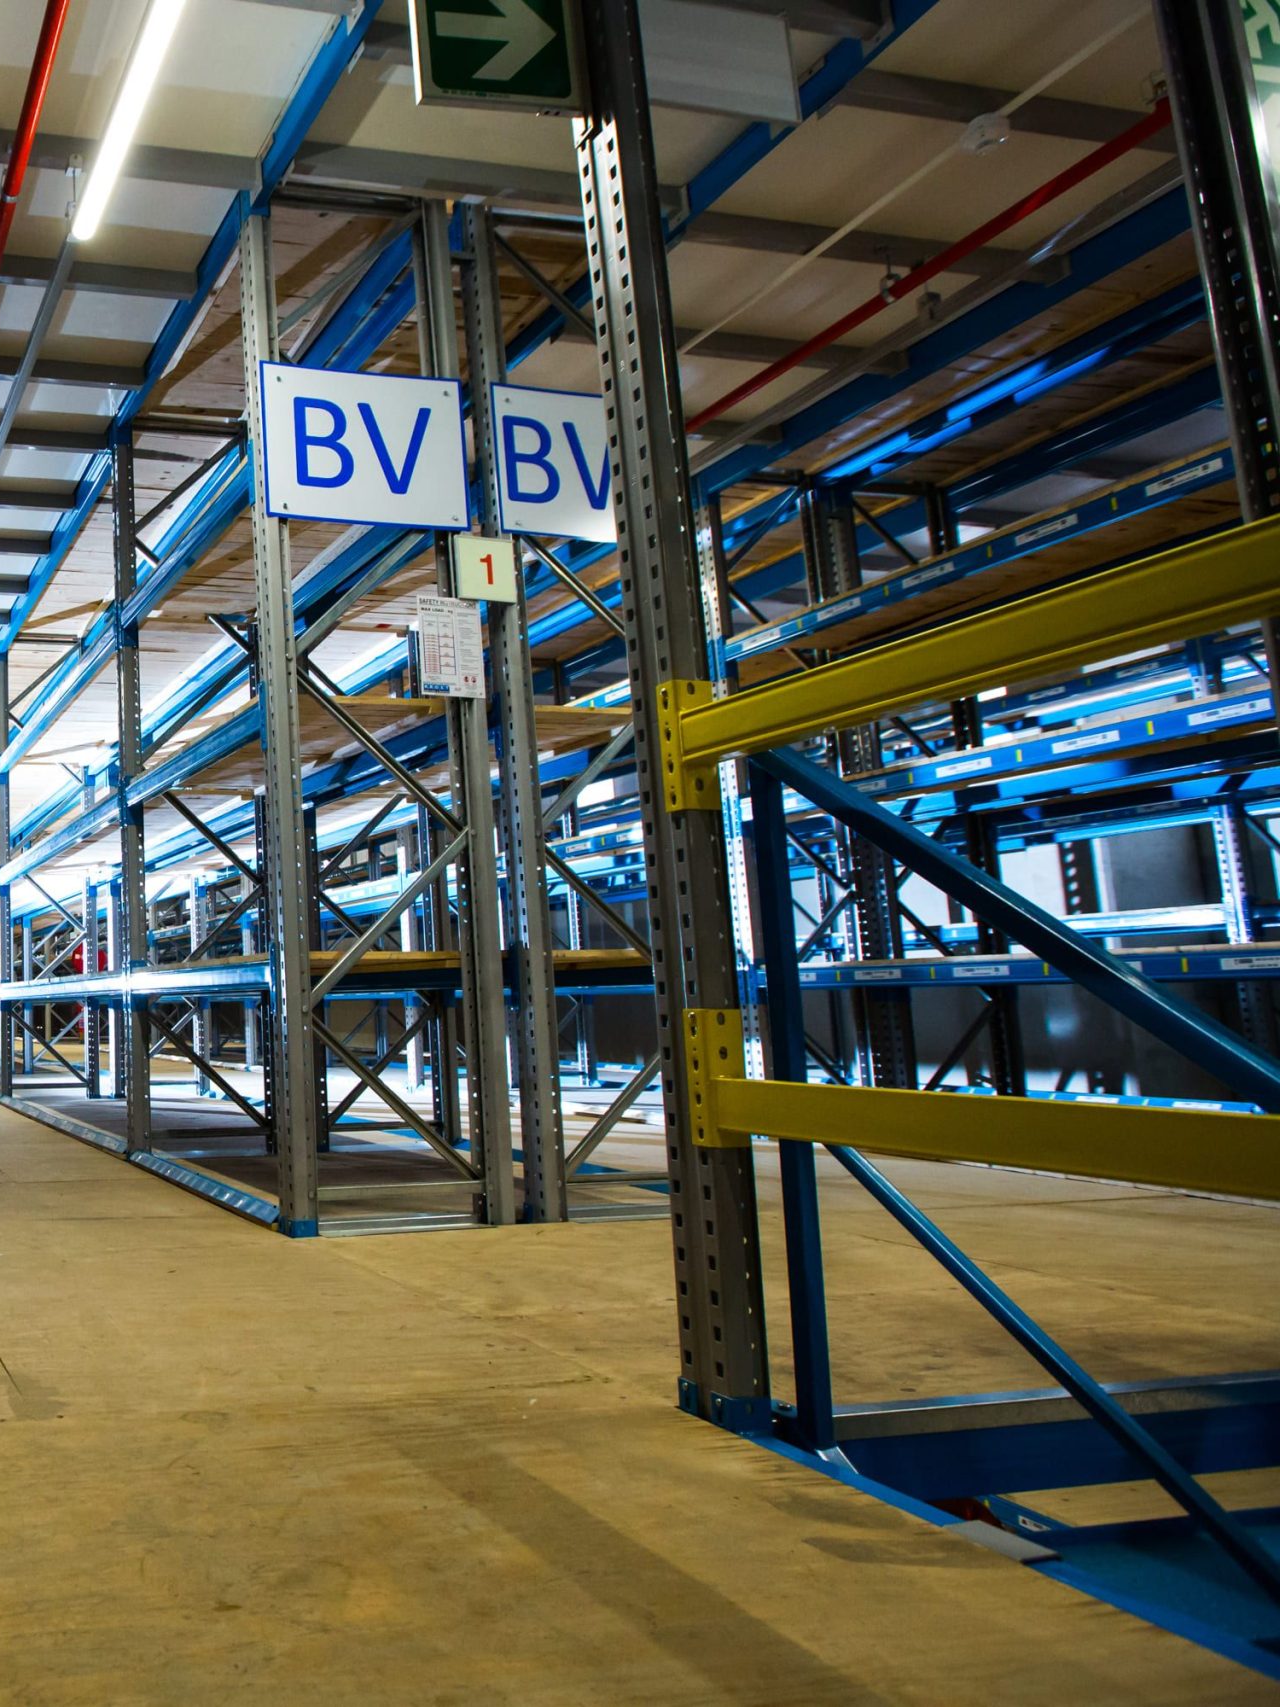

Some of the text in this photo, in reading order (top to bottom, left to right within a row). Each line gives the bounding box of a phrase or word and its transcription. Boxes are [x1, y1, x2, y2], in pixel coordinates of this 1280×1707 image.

[293, 396, 431, 494] BV
[502, 414, 610, 510] BV
[480, 553, 493, 585] 1
